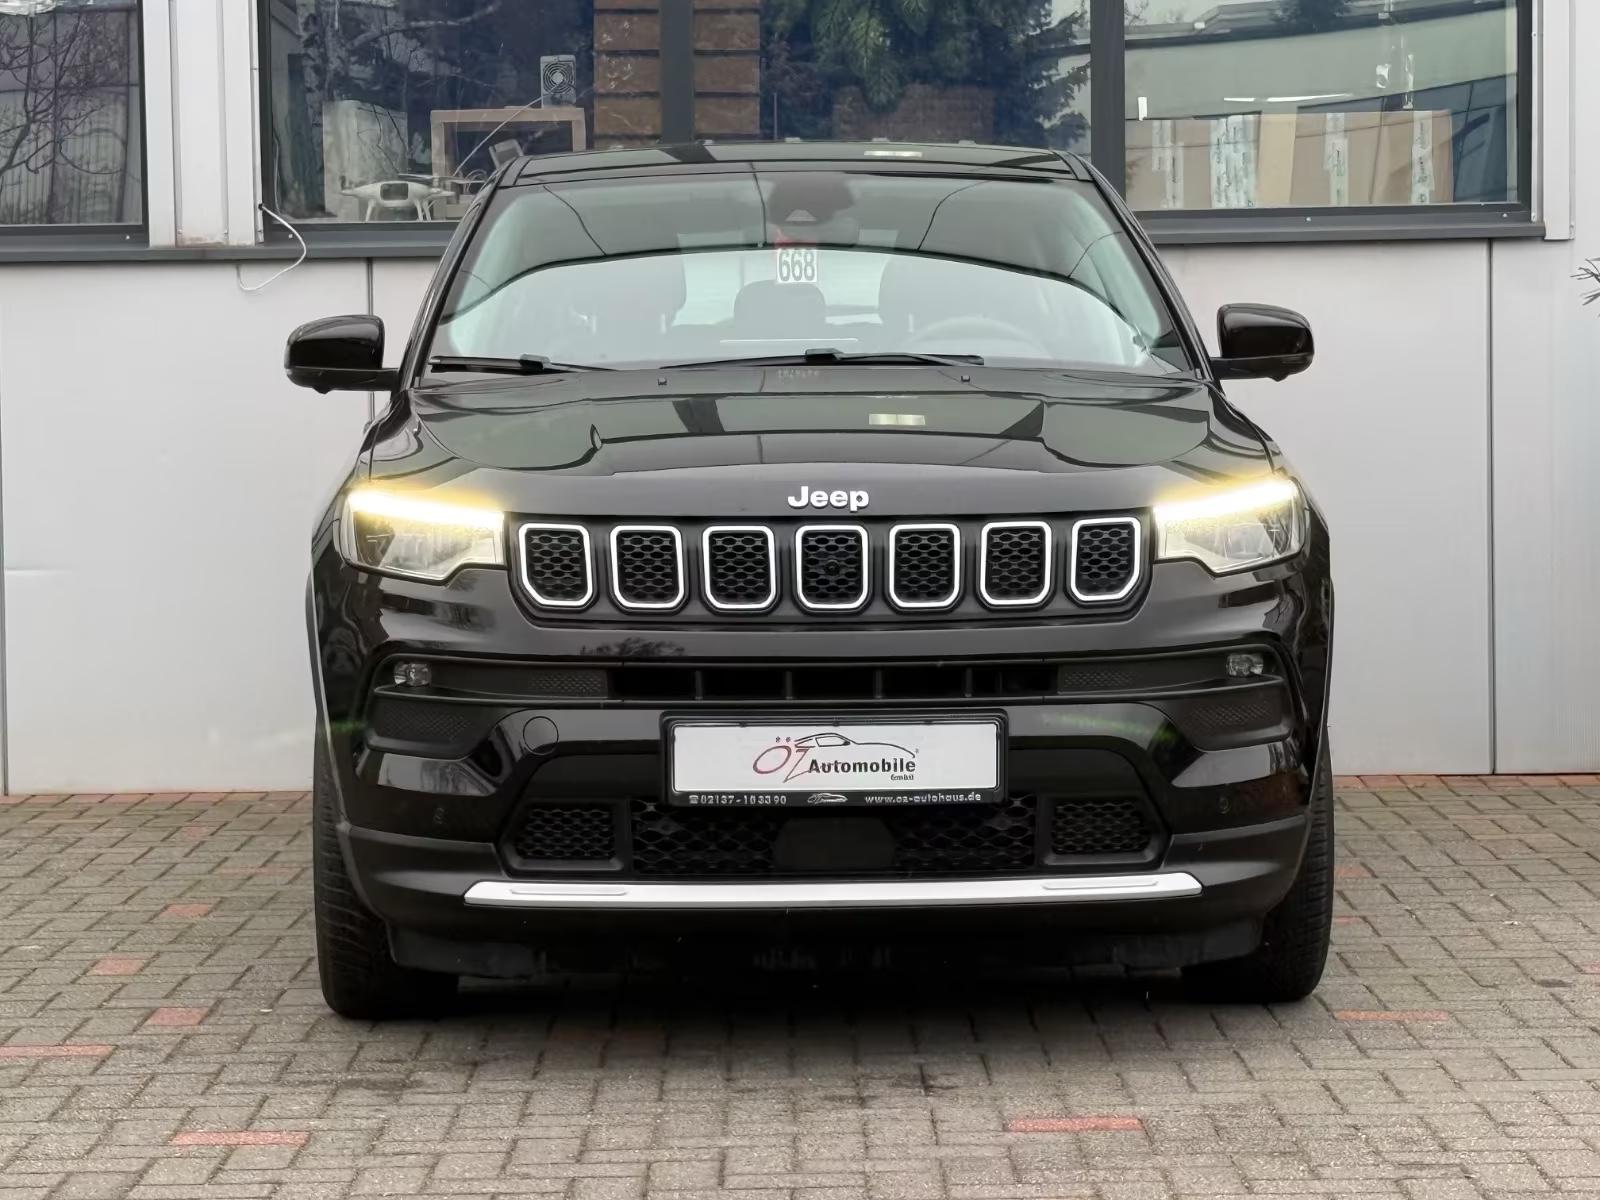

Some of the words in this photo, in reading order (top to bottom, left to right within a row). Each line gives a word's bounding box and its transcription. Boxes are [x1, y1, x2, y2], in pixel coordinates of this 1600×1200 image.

[778, 250, 816, 282] 668
[787, 485, 870, 512] Jeep
[808, 758, 916, 774] Automobile
